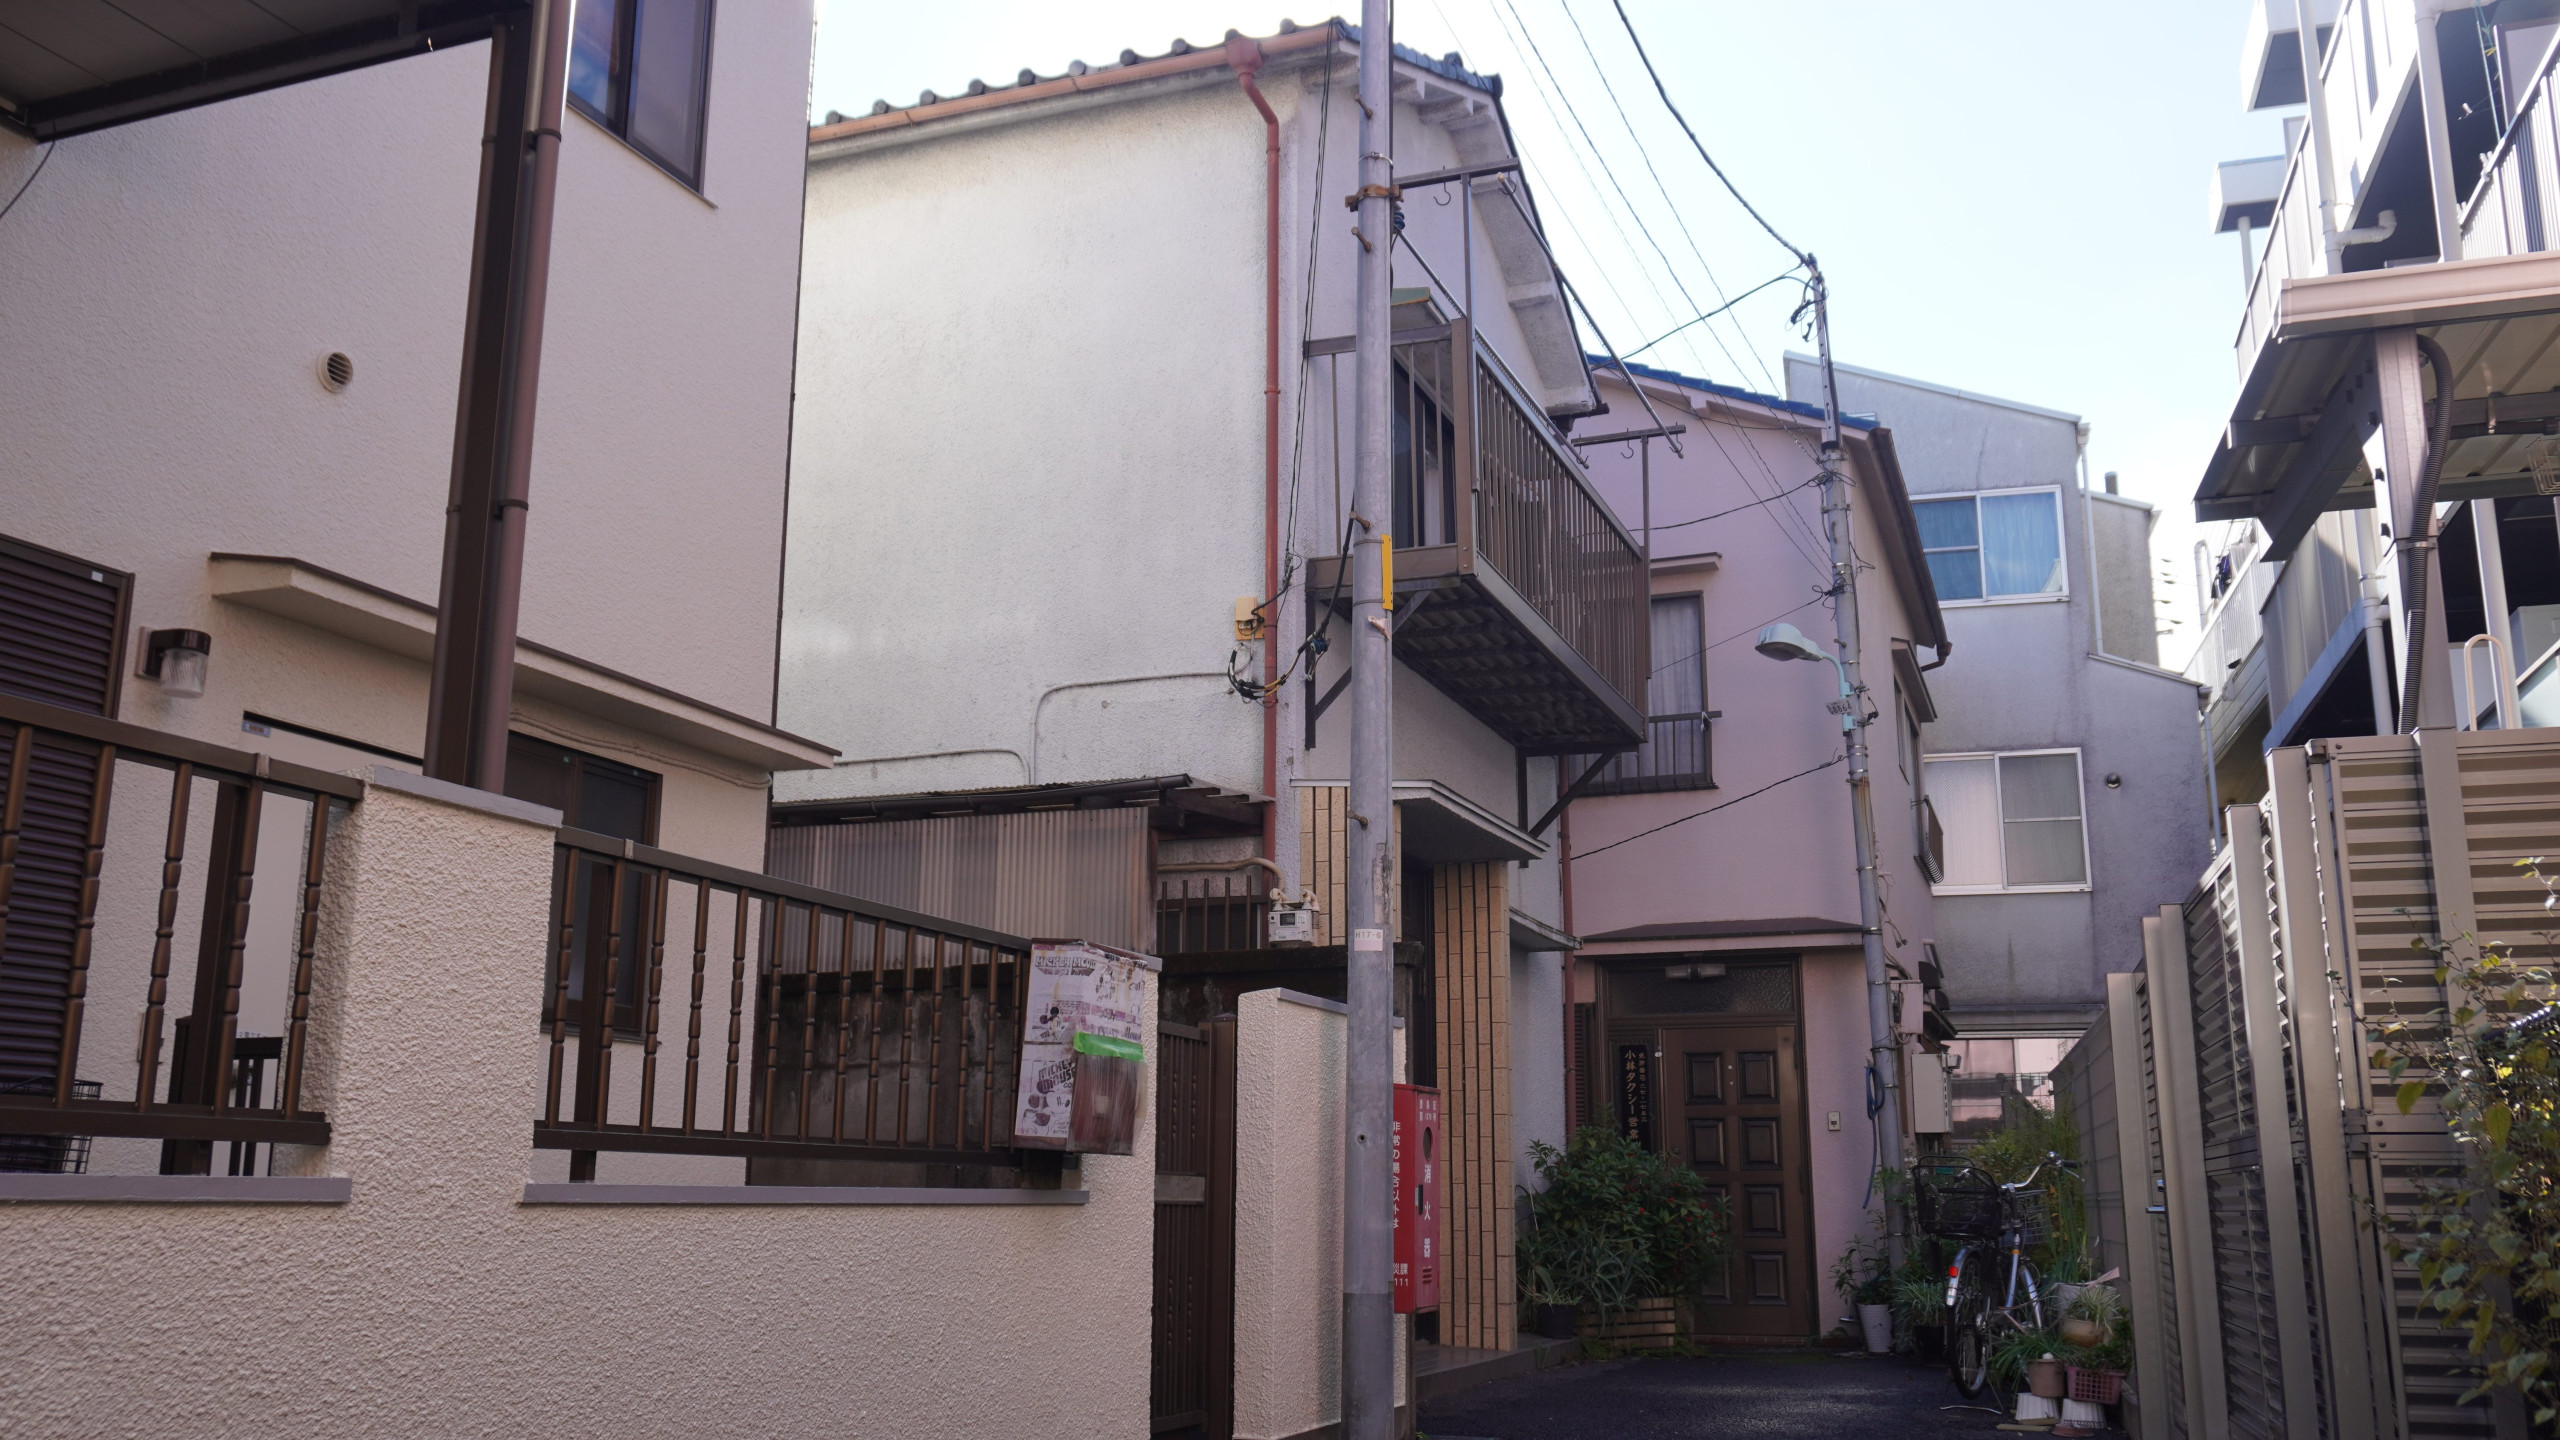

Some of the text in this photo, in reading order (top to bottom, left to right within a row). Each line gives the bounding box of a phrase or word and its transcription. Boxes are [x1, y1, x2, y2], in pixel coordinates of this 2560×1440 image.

[1624, 1050, 1639, 1143] 小林タクシー営業
